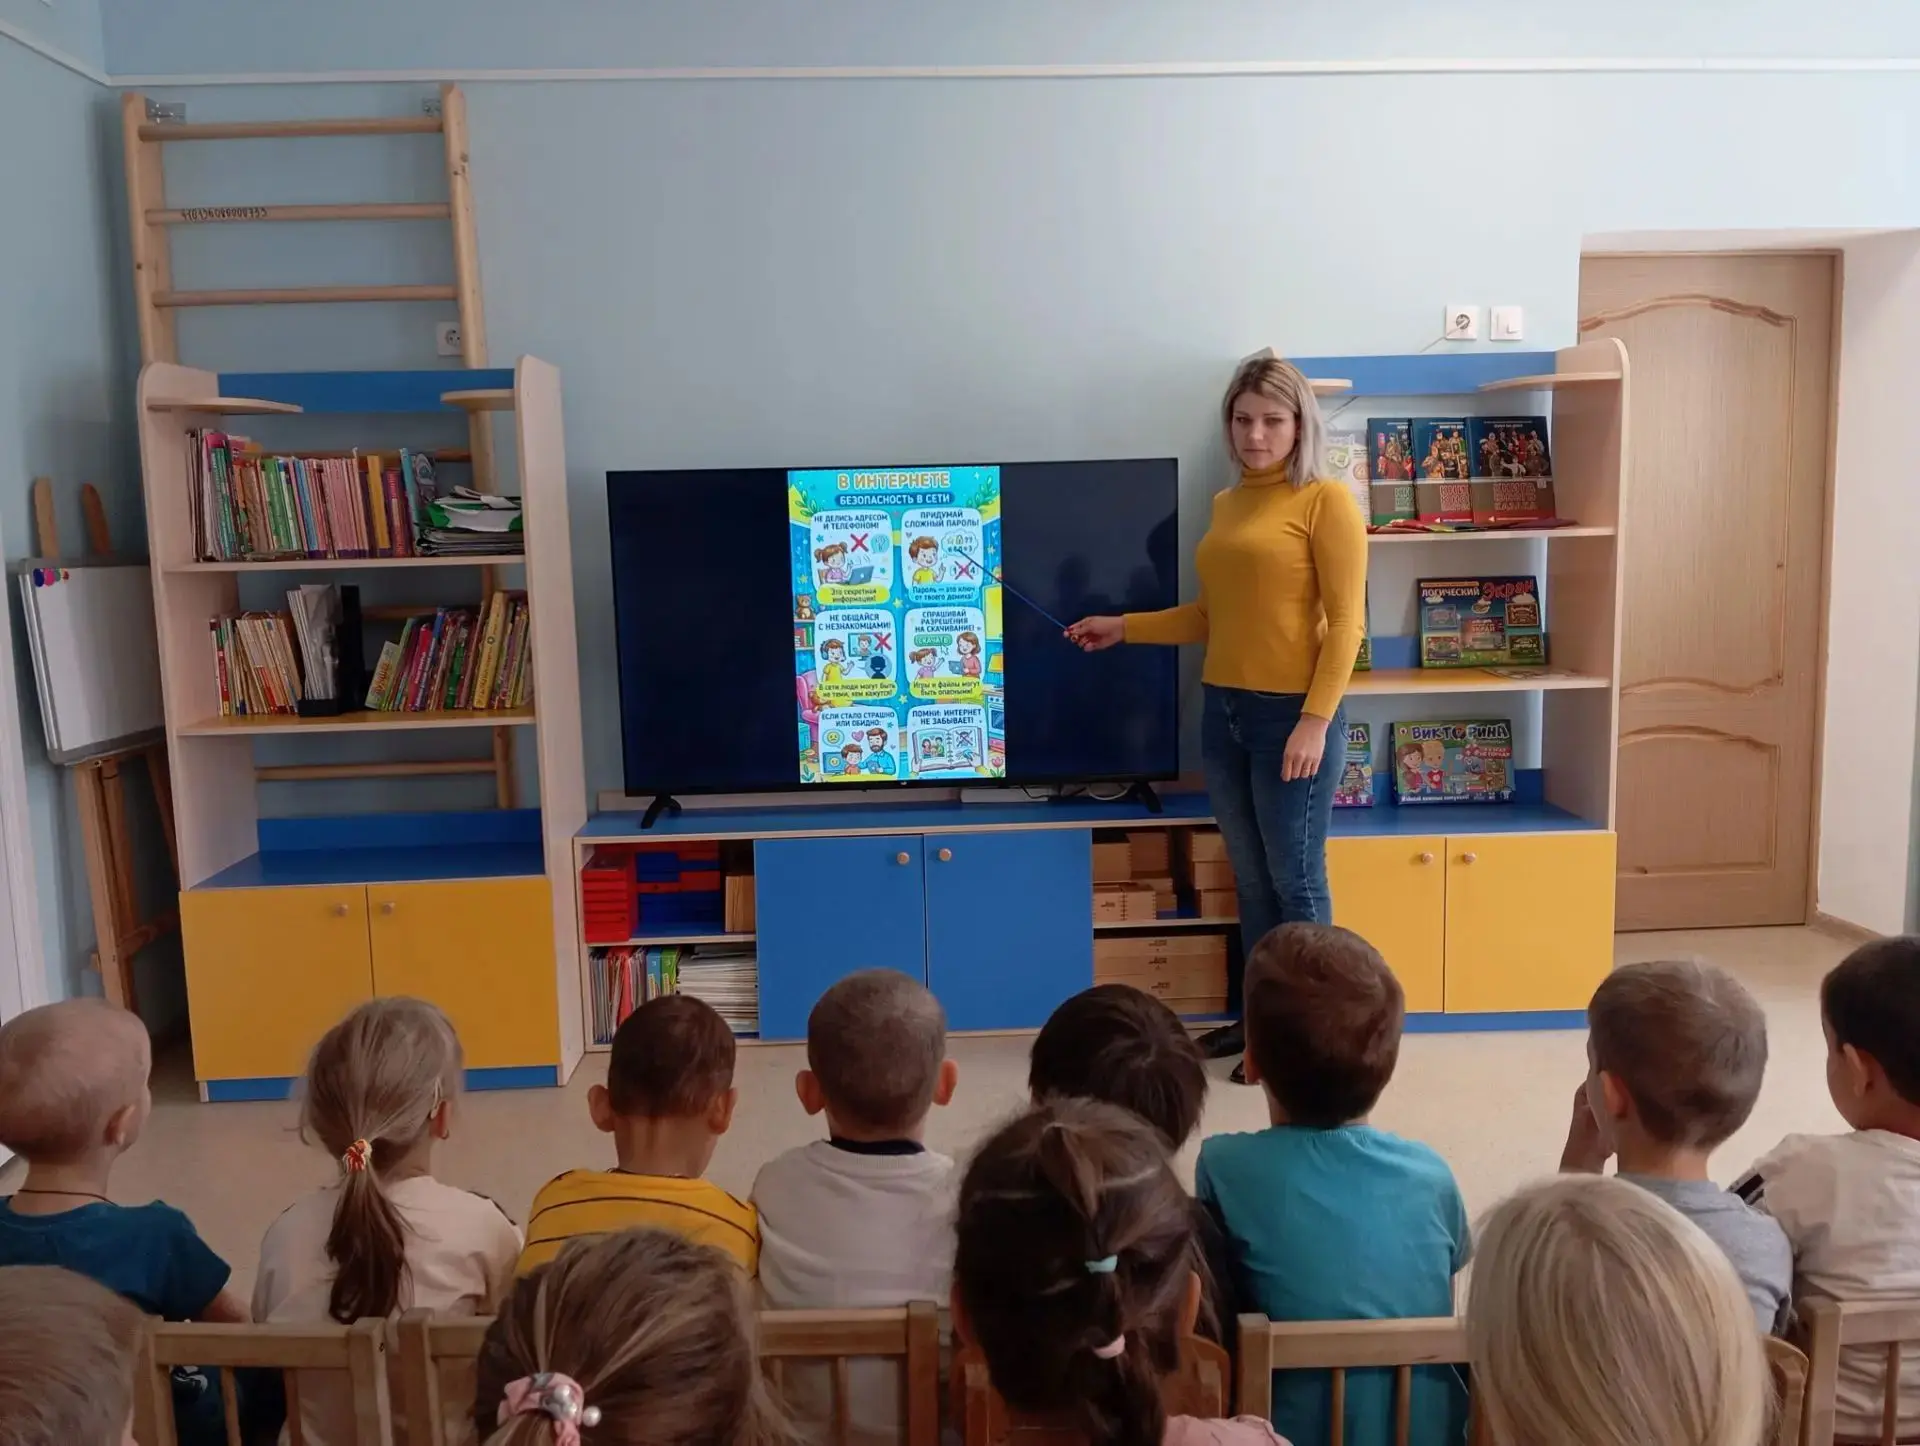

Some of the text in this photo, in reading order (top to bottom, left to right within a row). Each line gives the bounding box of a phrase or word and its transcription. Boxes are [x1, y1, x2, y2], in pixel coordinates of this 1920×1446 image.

[837, 471, 951, 490] В ИНТЕРНЕТЕ
[840, 493, 950, 505] БЕЗОПАСНОСТЬ В СЕТИ
[920, 510, 963, 520] ПРИДУМАЙ
[831, 522, 879, 530] ТЕЛЕФОНОМ!
[904, 520, 944, 528] СЛОЖНЫЙ
[844, 588, 877, 597] секретная
[913, 586, 937, 594] Пароль
[1422, 586, 1480, 597] ЛОГИЧЕСКИЙ
[947, 593, 973, 601] домика!
[829, 613, 879, 622] НЕ ОБЩАЙСЯ
[922, 609, 967, 618] СПРАШИВАЙ
[825, 622, 891, 631] НЕЗНАКОМЦАМИ!
[927, 625, 975, 633] СКАЧИВАНИЕ!
[921, 688, 973, 696] быть опасными!
[912, 709, 982, 718] ПОМНИ: ИНТЕРНЕТ
[932, 717, 974, 725] ЗАБЫВАЕТ!
[1411, 723, 1510, 740] ВИКТОРИНА
